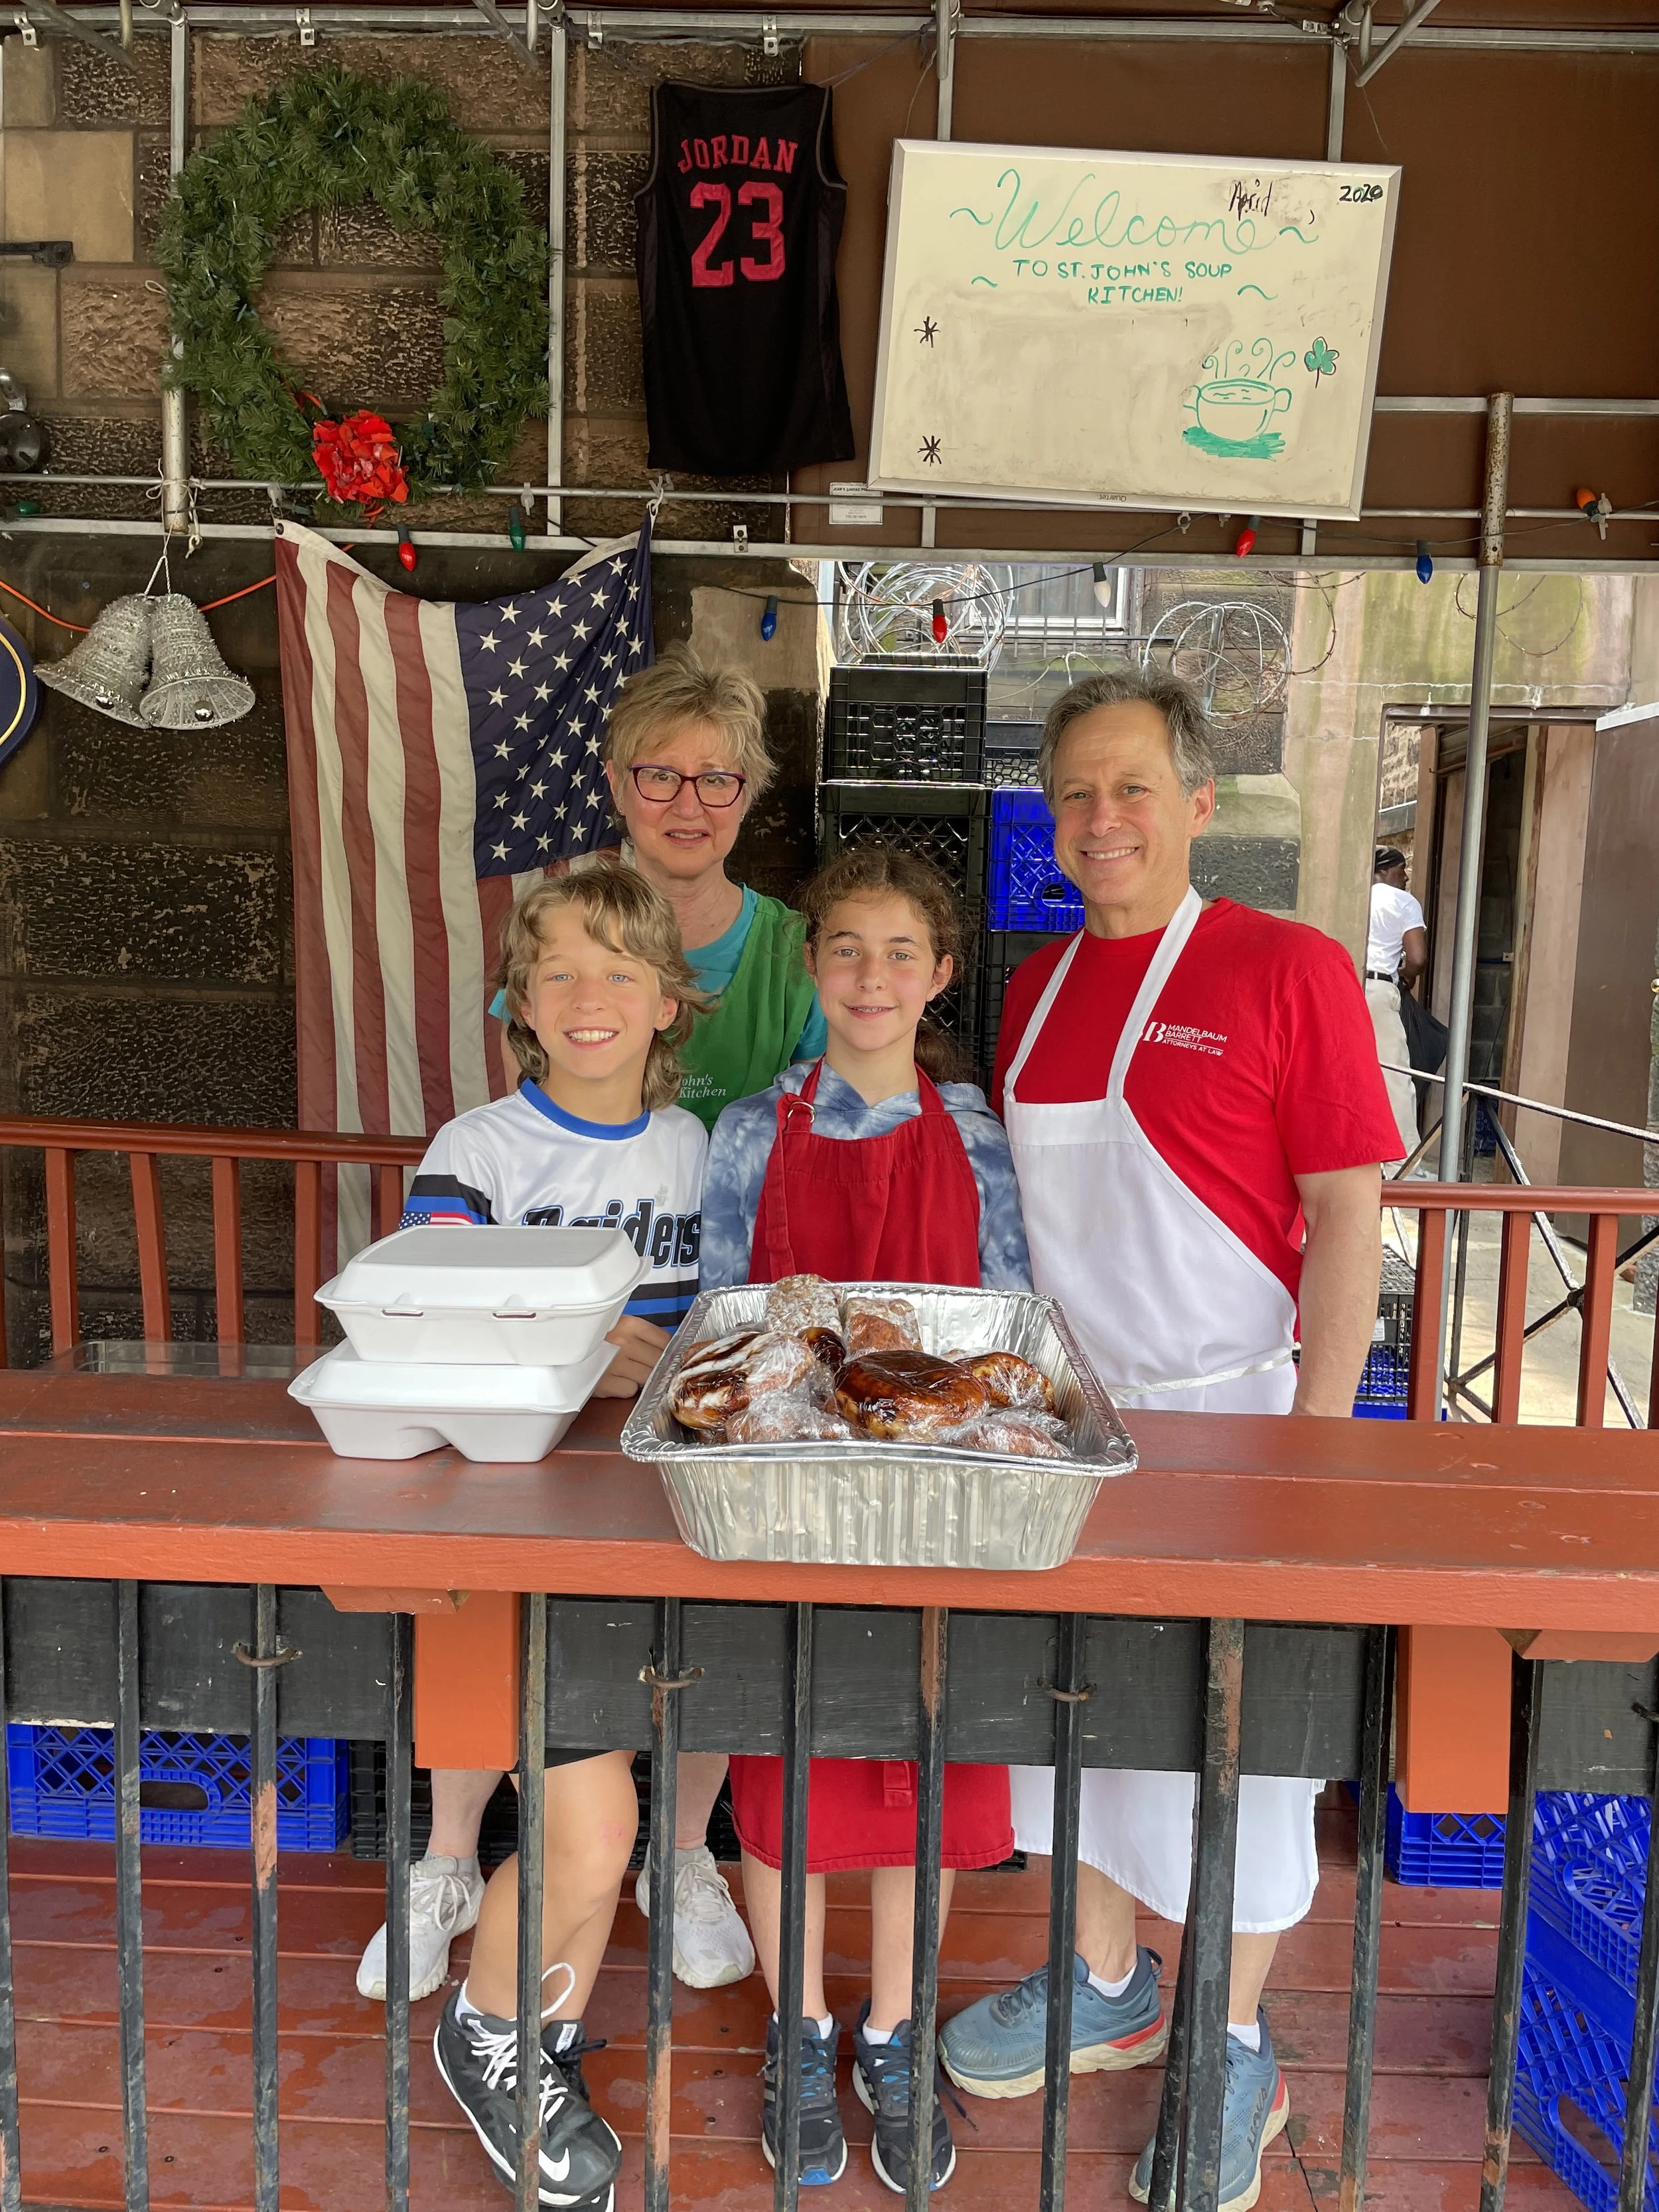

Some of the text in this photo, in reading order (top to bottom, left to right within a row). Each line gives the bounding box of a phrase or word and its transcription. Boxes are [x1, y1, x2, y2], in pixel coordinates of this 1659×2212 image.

[678, 134, 798, 174] JORDAN
[1339, 184, 1384, 202] 2020
[995, 169, 1277, 255] Welcome
[690, 181, 786, 287] 23
[1013, 259, 1048, 276] TO
[1185, 261, 1232, 279] SOUP
[1088, 285, 1183, 304] KITCHEN!
[1165, 1030, 1202, 1043] BARRETT
[1167, 1024, 1228, 1043] MANDELBAUM
[1162, 1039, 1197, 1050] ATTORNEYS
[682, 1074, 713, 1086] ohn's
[679, 1086, 727, 1098] Kitchen
[521, 1199, 701, 1268] iders
